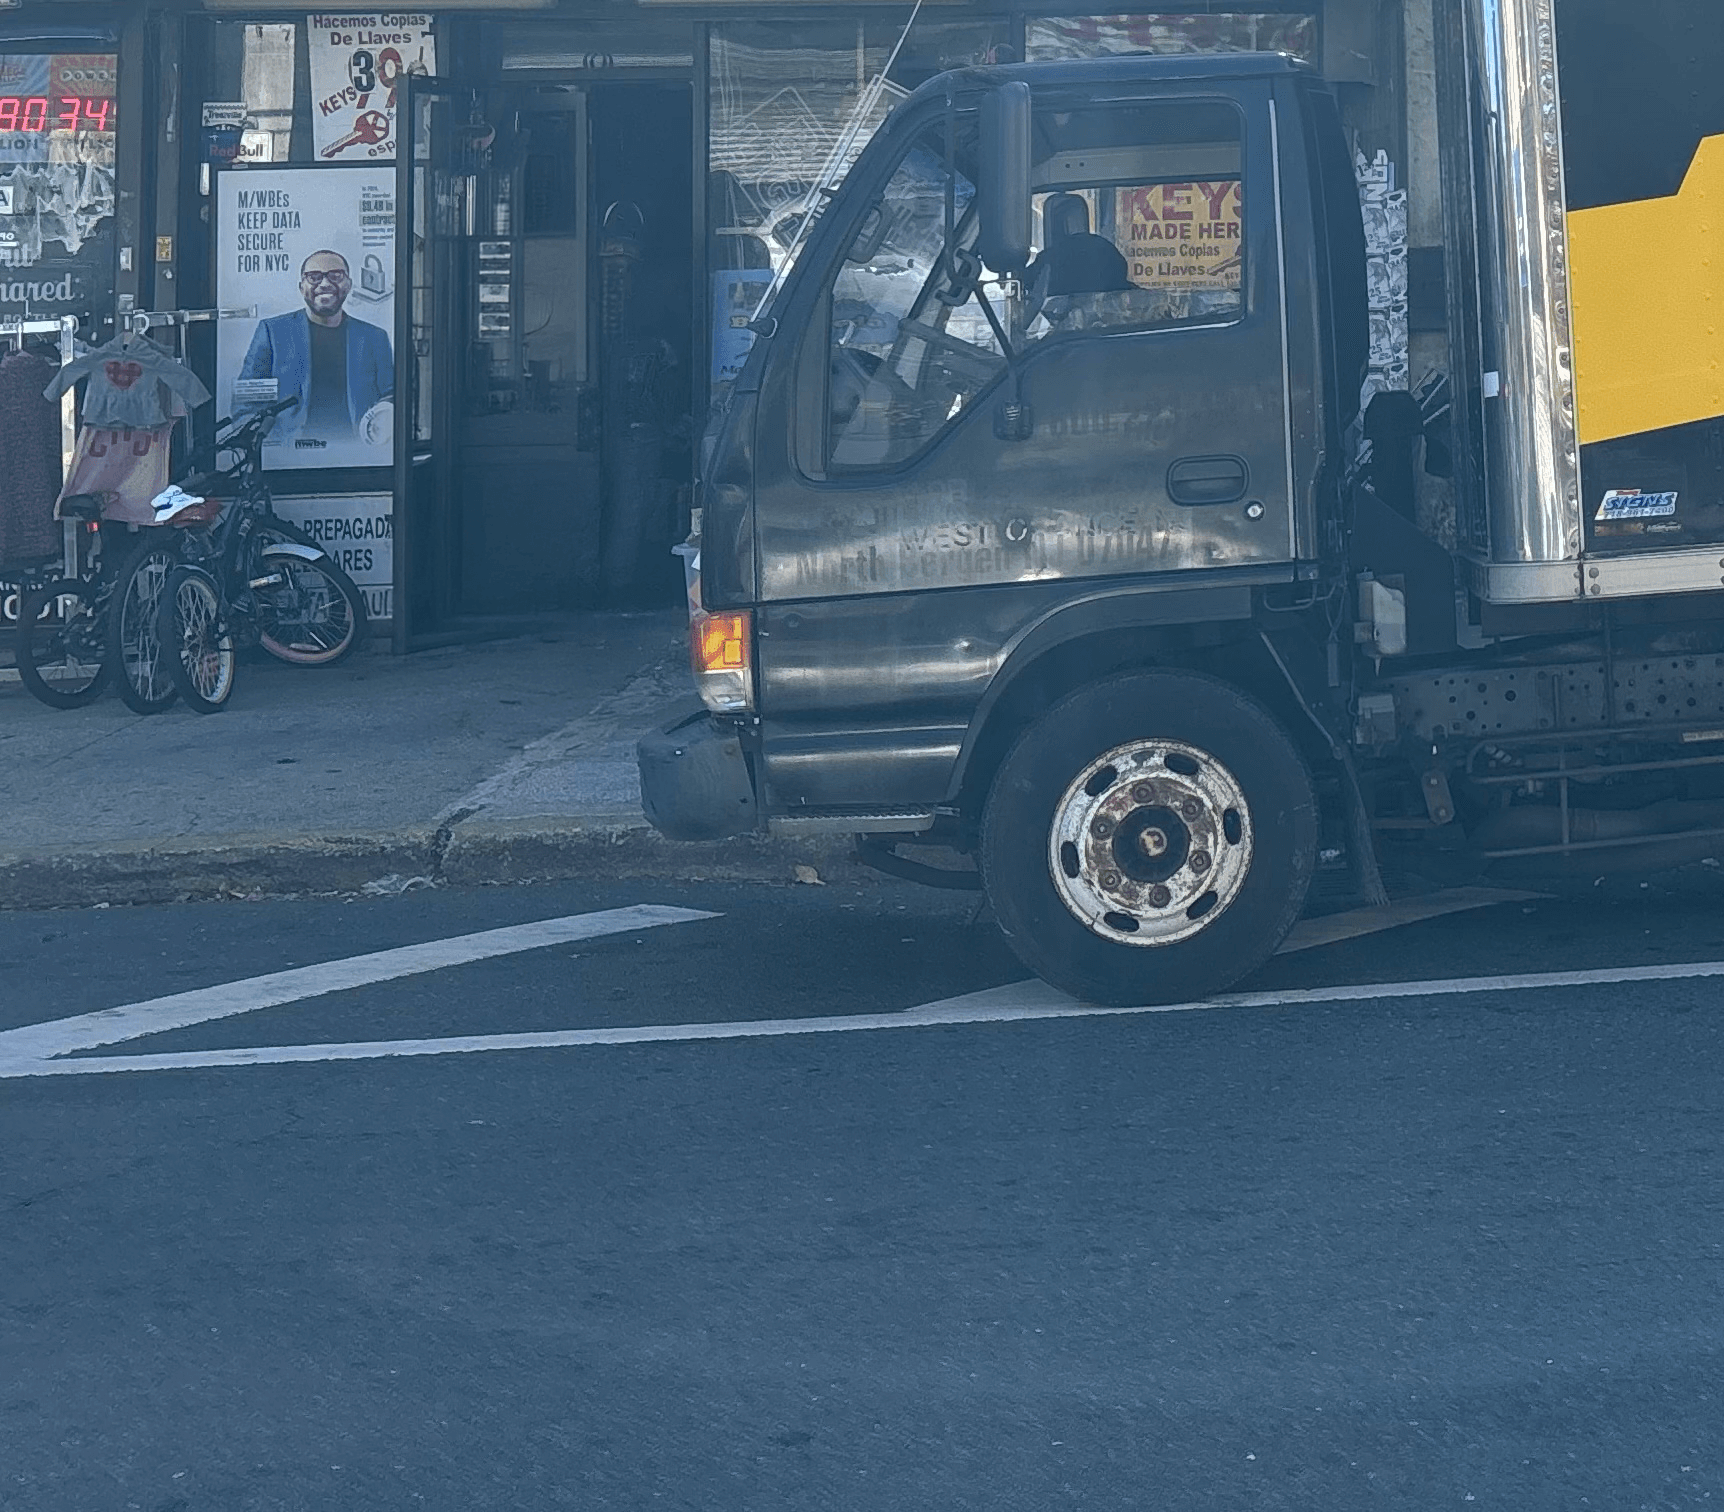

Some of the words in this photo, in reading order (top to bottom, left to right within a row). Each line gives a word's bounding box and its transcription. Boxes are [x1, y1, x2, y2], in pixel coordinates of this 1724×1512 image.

[313, 14, 377, 29] Hacemos
[381, 14, 427, 29] Copias
[330, 32, 353, 45] De
[358, 31, 412, 45] Llaves
[319, 86, 358, 116] KEYS
[240, 144, 264, 157] Bull
[368, 140, 396, 157] esp
[238, 190, 290, 208] M/WBEs
[238, 212, 267, 230] KEEP
[273, 211, 301, 229] DATA
[1131, 223, 1191, 240] MADE
[237, 233, 283, 250] SECURE
[1180, 243, 1220, 259] Copias
[238, 254, 260, 272] FOR
[265, 254, 289, 272] NYC
[1134, 263, 1154, 276] De
[1158, 262, 1206, 276] Llaves
[1603, 493, 1675, 510] SIGNS
